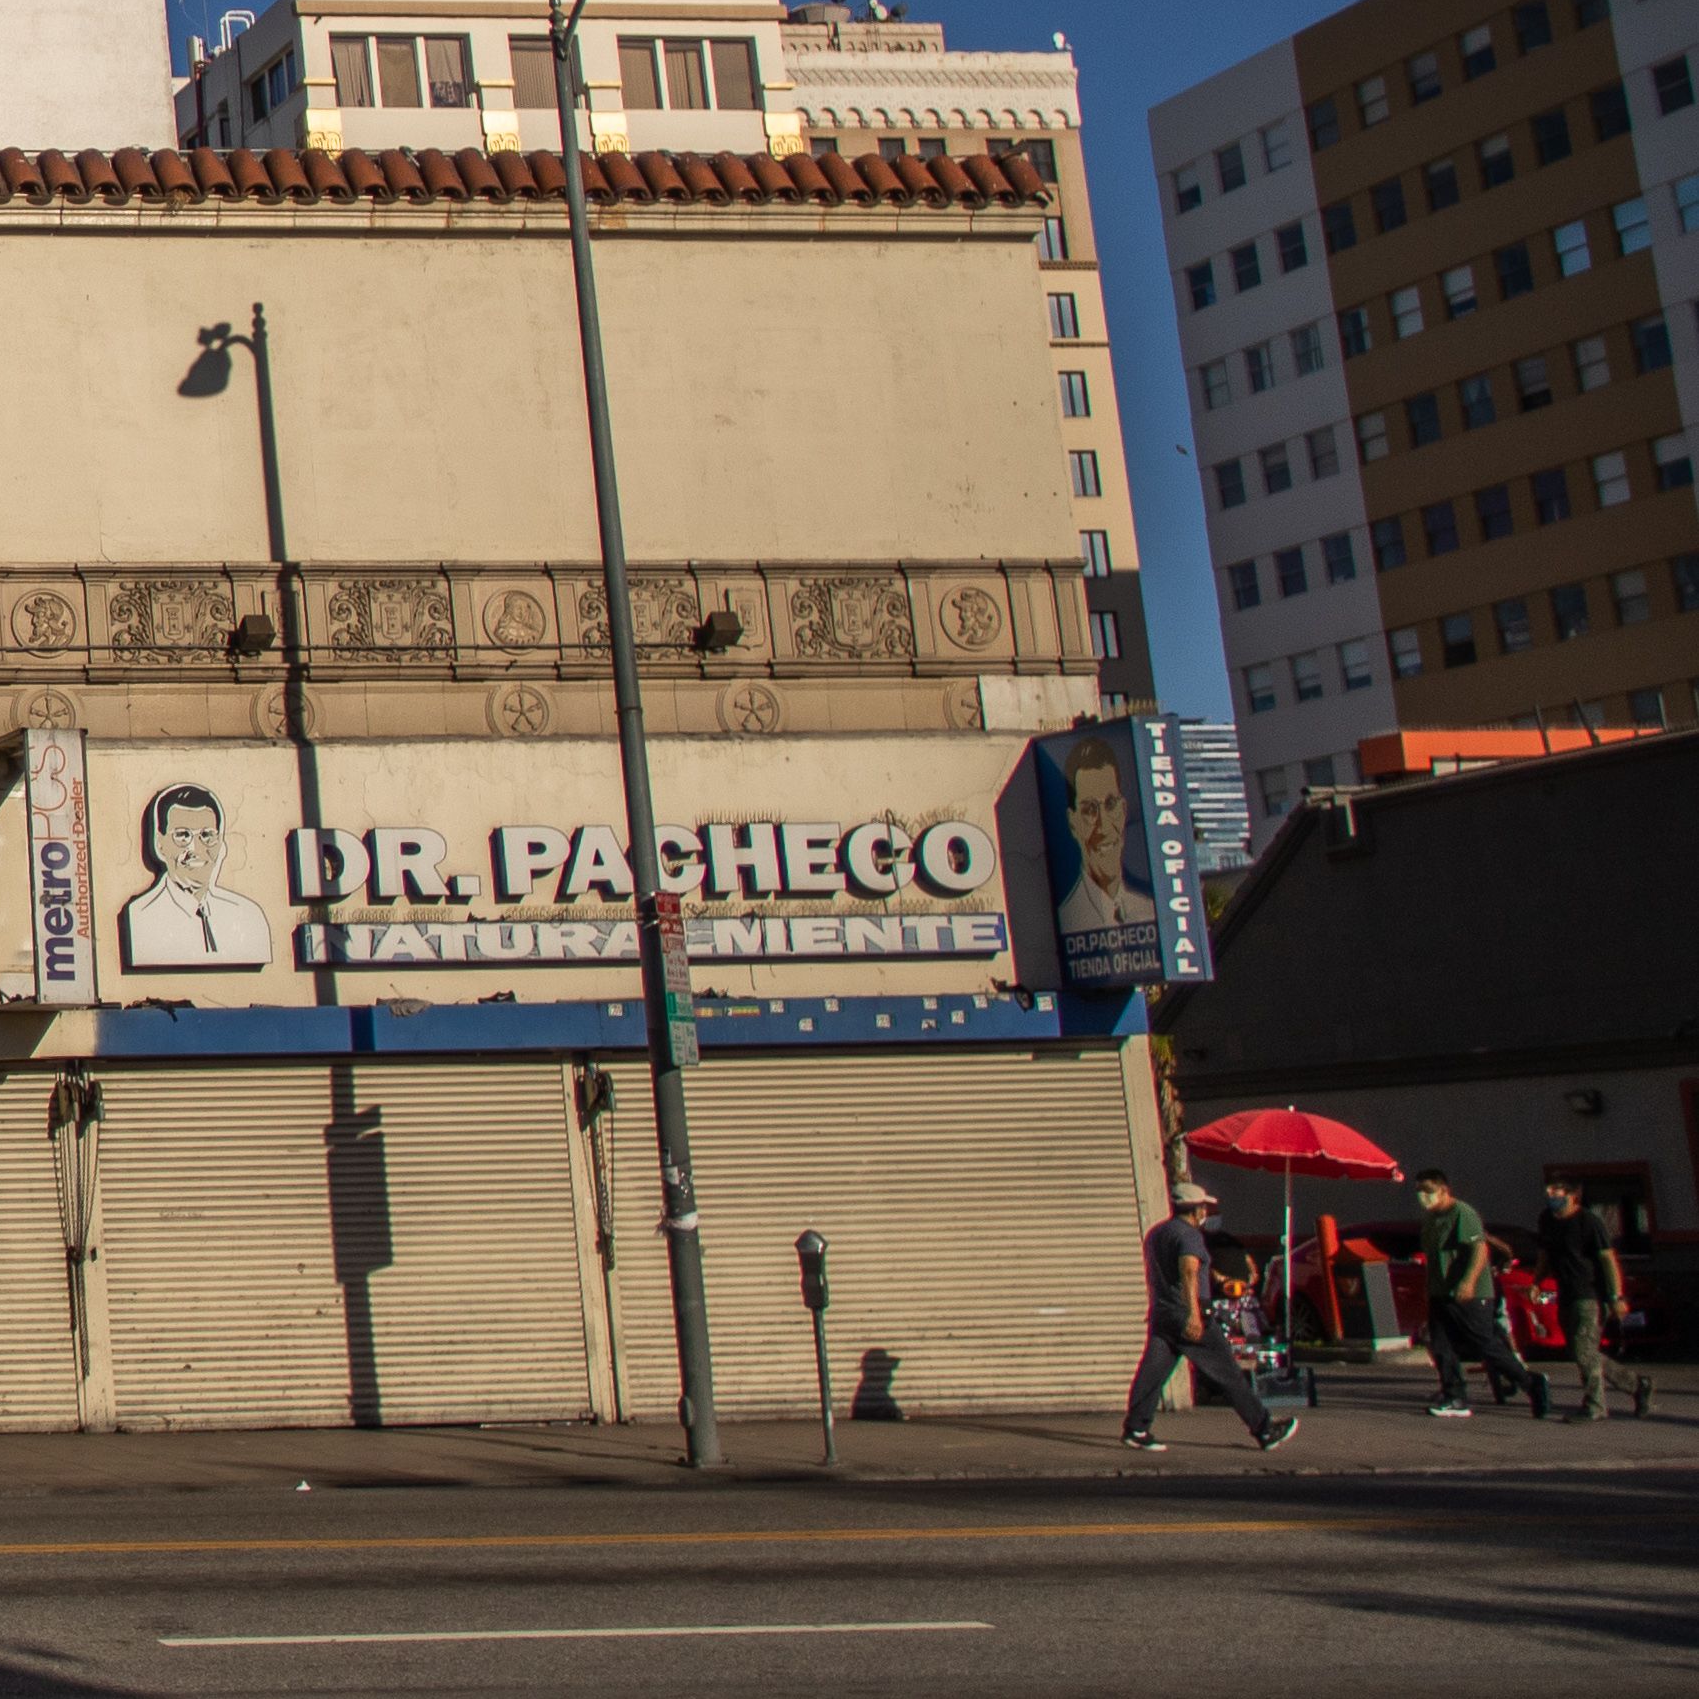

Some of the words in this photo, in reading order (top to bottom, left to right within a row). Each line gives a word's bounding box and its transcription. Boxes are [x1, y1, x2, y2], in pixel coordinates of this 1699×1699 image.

[71, 776, 86, 838] Dealer
[1144, 722, 1180, 826] TIENDA
[73, 840, 90, 940] Authorized
[289, 826, 481, 905] DR.
[491, 820, 997, 904] PACHECO
[1160, 839, 1199, 975] OFICIAL
[1068, 956, 1111, 979] TIENDA
[1112, 949, 1161, 974] OFICIAL
